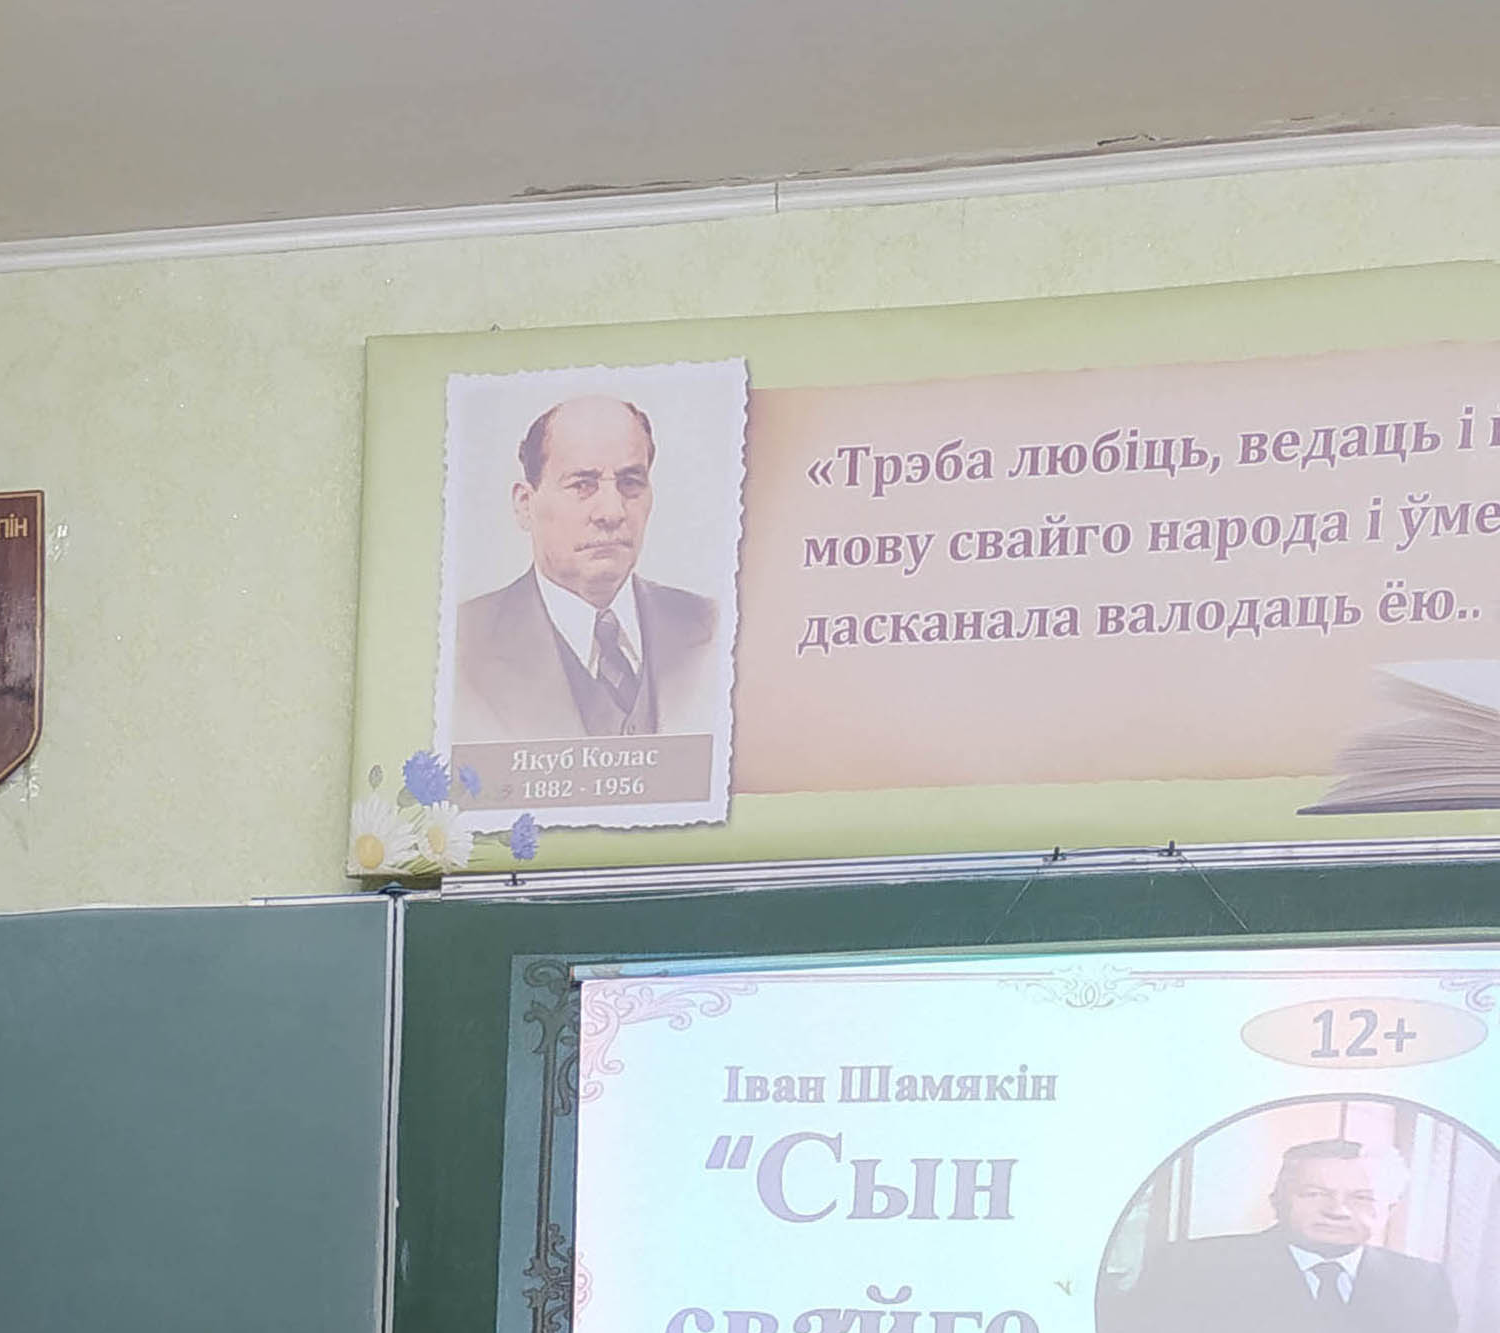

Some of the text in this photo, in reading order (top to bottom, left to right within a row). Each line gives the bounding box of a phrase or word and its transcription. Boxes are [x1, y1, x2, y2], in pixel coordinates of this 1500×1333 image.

[807, 439, 994, 498] «Трэба
[1008, 428, 1221, 477] любіць,
[1238, 421, 1441, 470] ведаць
[1457, 406, 1474, 450] і
[803, 532, 935, 576] мову
[949, 514, 1131, 561] свайго
[1148, 511, 1349, 562] народа
[1366, 497, 1382, 540] і
[798, 605, 1080, 656] дасканала
[1097, 595, 1362, 639] валодаць
[511, 747, 659, 774] Якуб Колас
[523, 780, 573, 799] 1882
[593, 776, 645, 796] 1956
[1311, 1008, 1417, 1058] 12+
[723, 1063, 1059, 1104] Іван Шамякін
